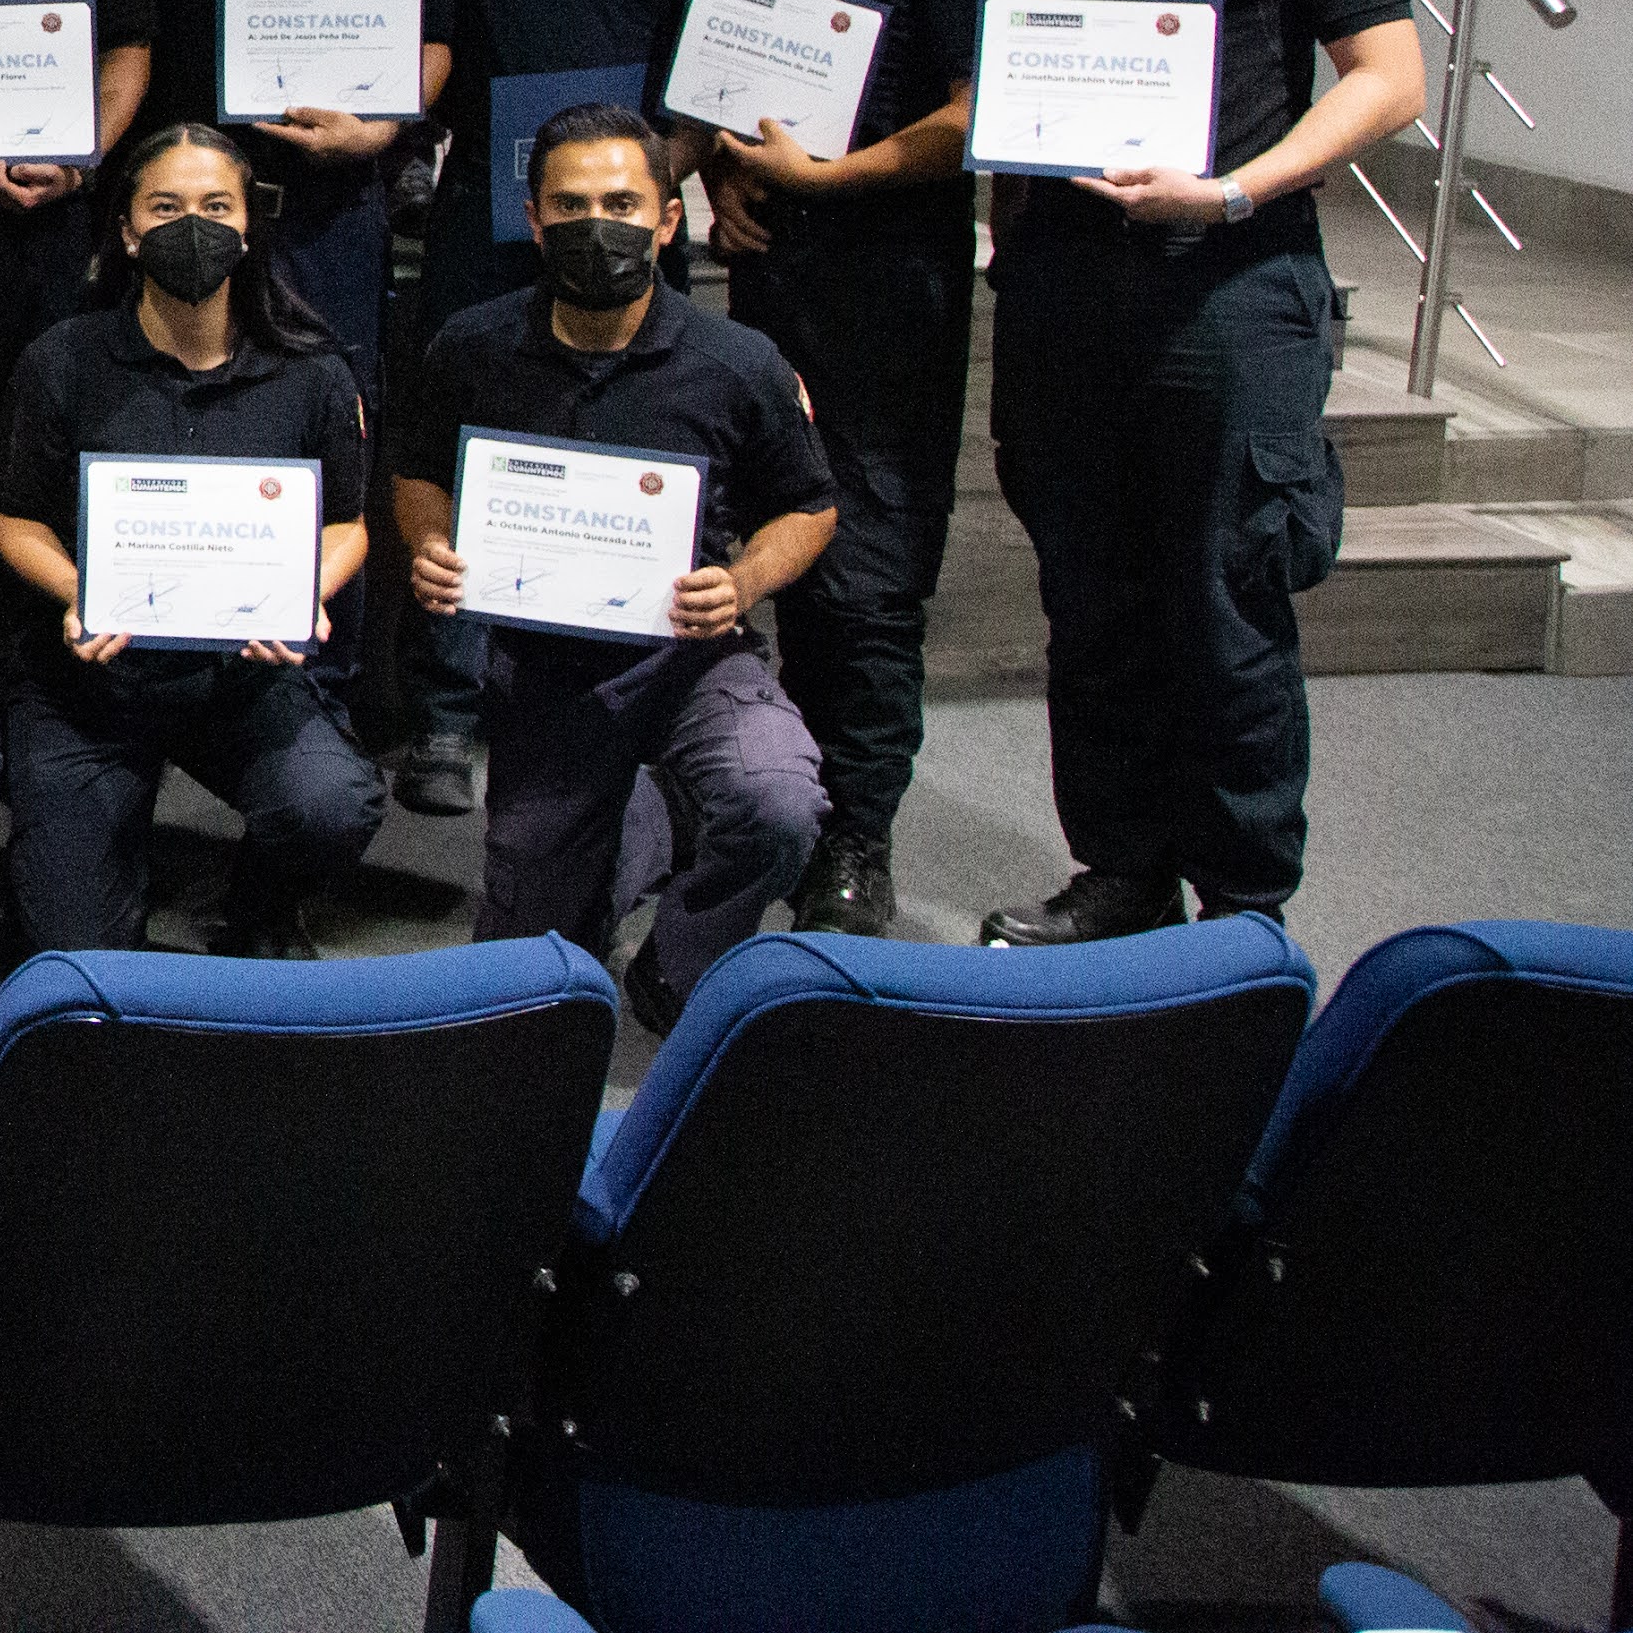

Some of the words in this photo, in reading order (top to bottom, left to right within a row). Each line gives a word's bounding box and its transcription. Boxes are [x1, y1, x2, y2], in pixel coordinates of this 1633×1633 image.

[247, 14, 387, 29] CONSTANCIA
[706, 15, 834, 67] CONSTANCIA
[1007, 51, 1171, 74] CONSTANCIA
[0, 73, 26, 81] Flores
[1020, 73, 1065, 82] Jonathan
[1137, 78, 1171, 87] Ramos
[487, 497, 653, 535] CONSTANCIA
[114, 519, 276, 540] CONSTANCIA
[486, 519, 498, 527] A:
[499, 520, 538, 533] Octavio
[540, 526, 581, 539] Antonio
[629, 537, 652, 548] Lara
[128, 541, 166, 551] Mariana
[168, 542, 205, 551] Costilla
[208, 544, 234, 552] Nieto
